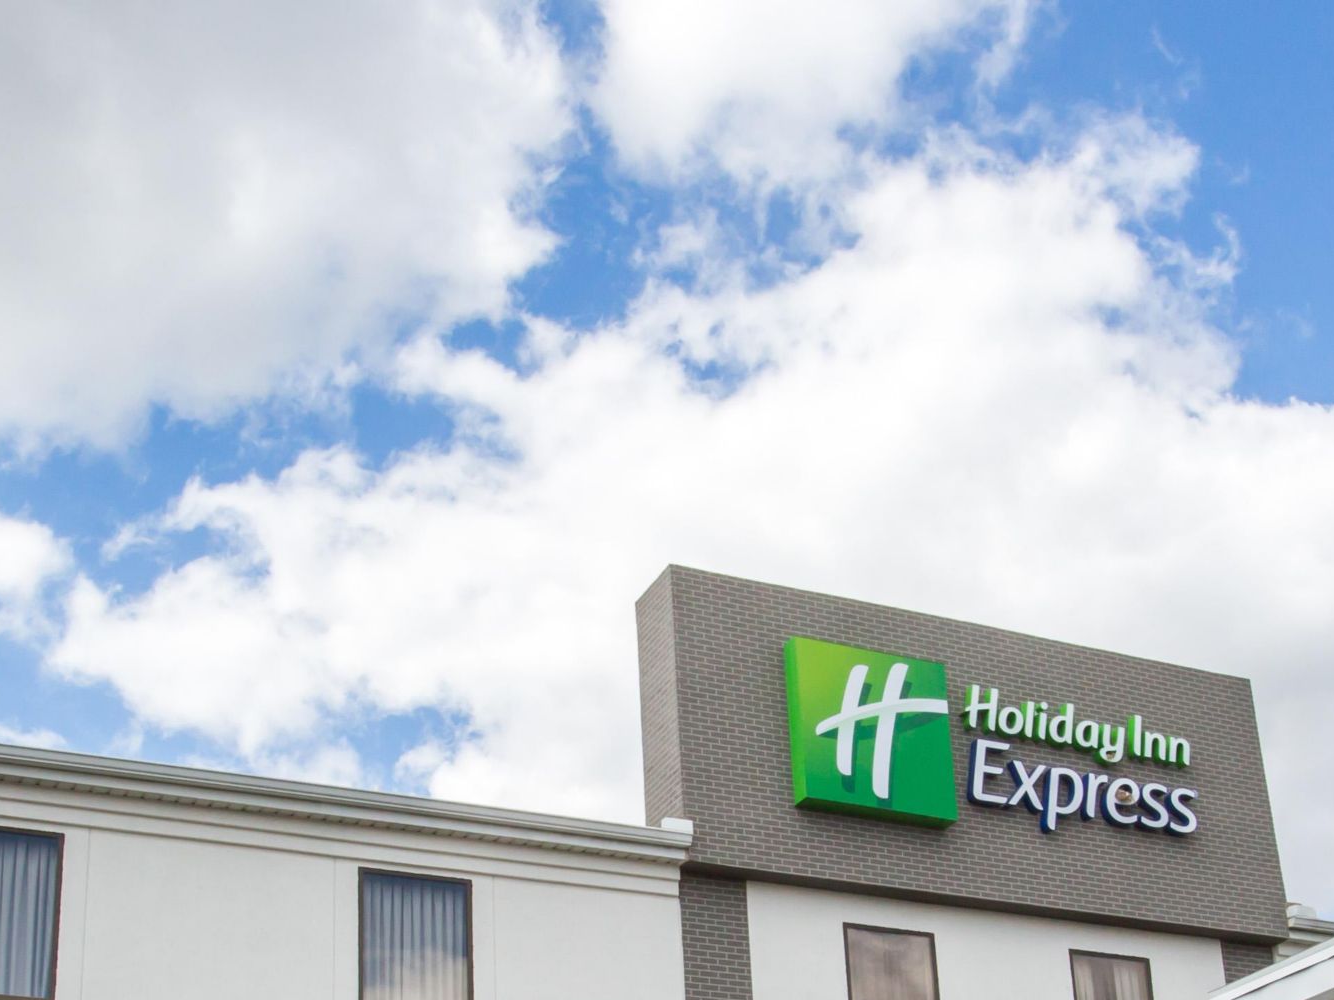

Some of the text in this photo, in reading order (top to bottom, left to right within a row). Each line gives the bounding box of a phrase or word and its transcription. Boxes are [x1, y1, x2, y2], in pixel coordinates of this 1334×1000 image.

[964, 683, 1191, 768] Holiday Inn
[967, 738, 1198, 835] Express
